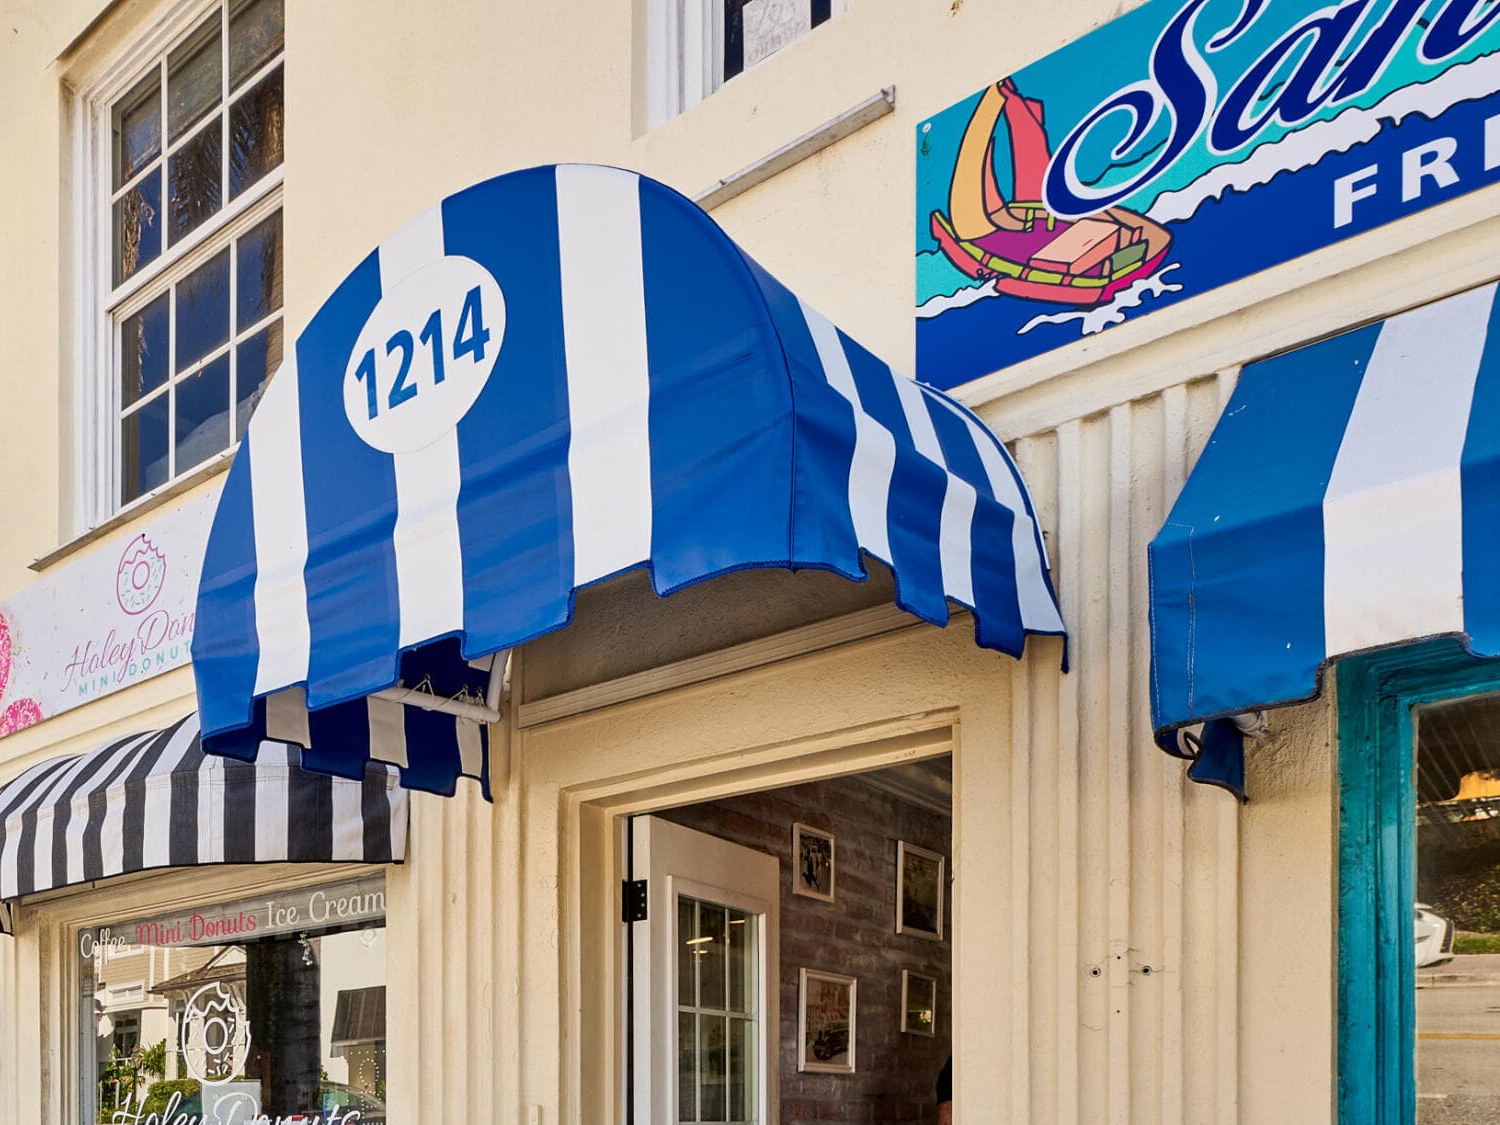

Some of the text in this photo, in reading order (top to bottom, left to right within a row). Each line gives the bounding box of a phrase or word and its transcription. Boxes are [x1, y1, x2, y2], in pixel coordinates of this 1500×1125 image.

[355, 284, 490, 421] 1214
[60, 629, 134, 692] Holey
[78, 674, 117, 697] MINI
[80, 891, 386, 966] Coffee Mini Donuts Ice Cream
